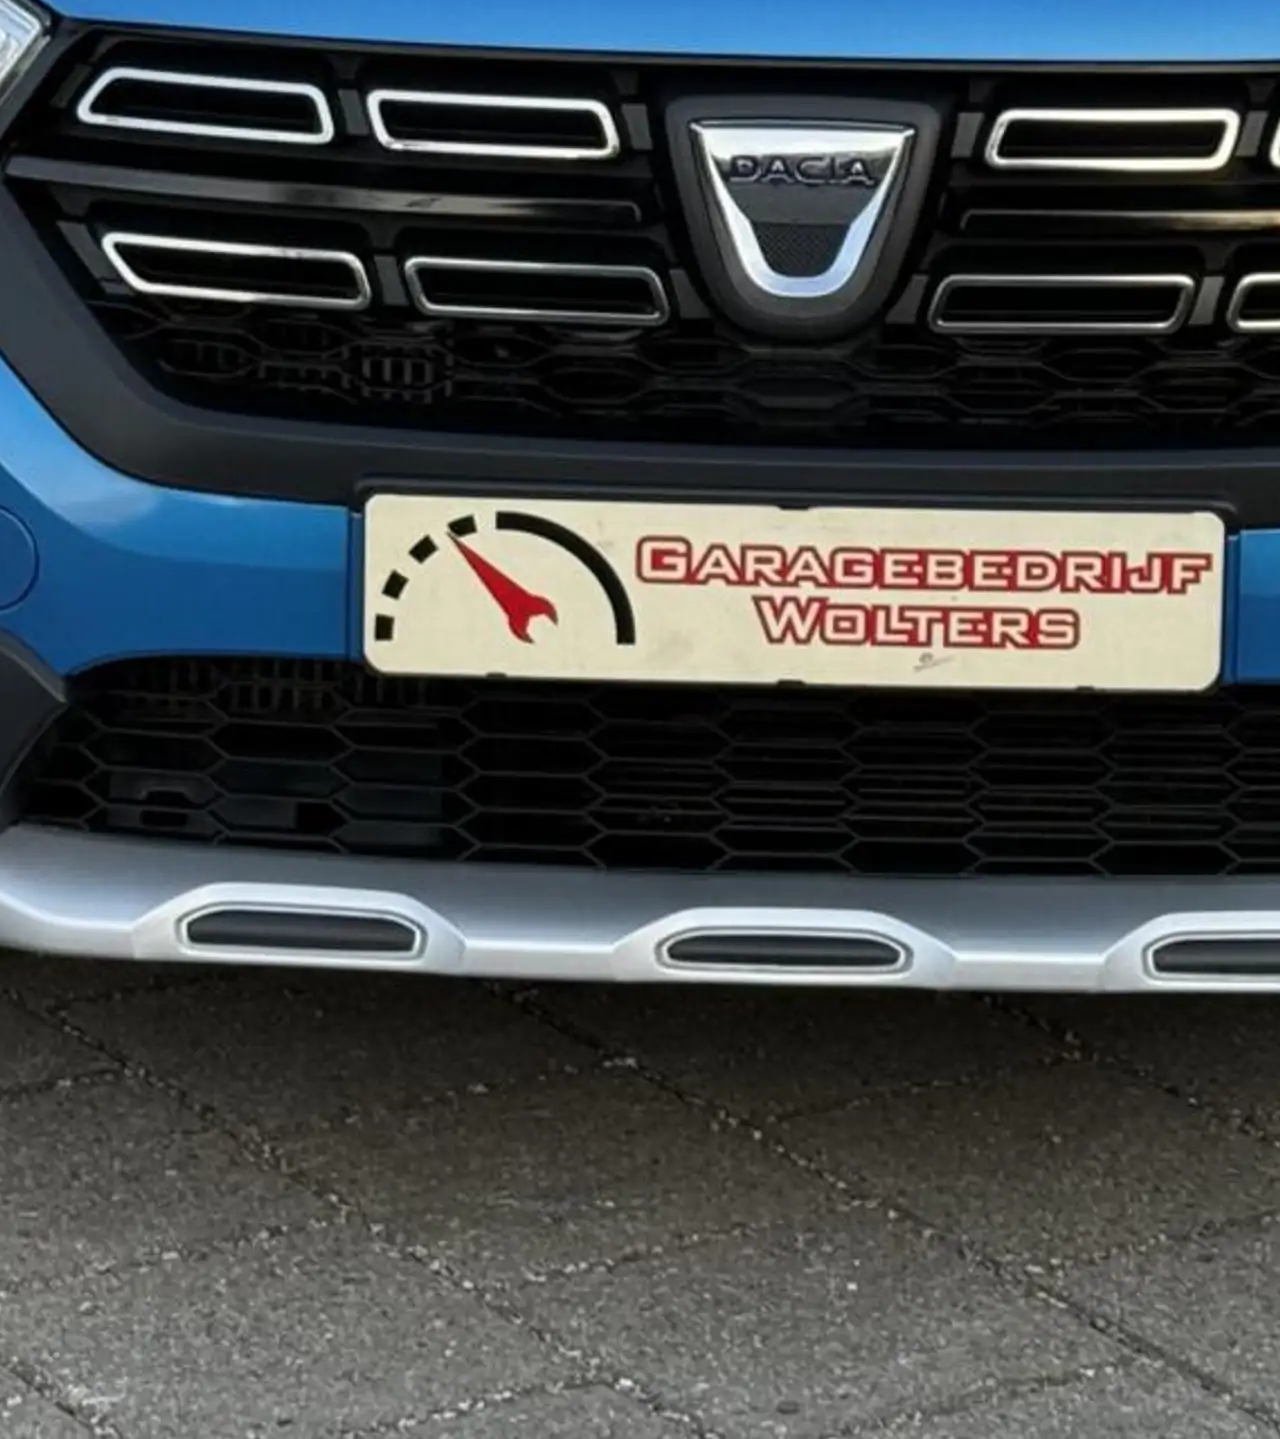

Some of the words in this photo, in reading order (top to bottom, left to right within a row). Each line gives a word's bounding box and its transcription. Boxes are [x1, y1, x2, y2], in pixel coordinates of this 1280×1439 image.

[728, 155, 874, 186] DACIA
[636, 535, 1212, 595] GARAGEBEDRIJF
[751, 594, 1081, 651] WOLTERS
